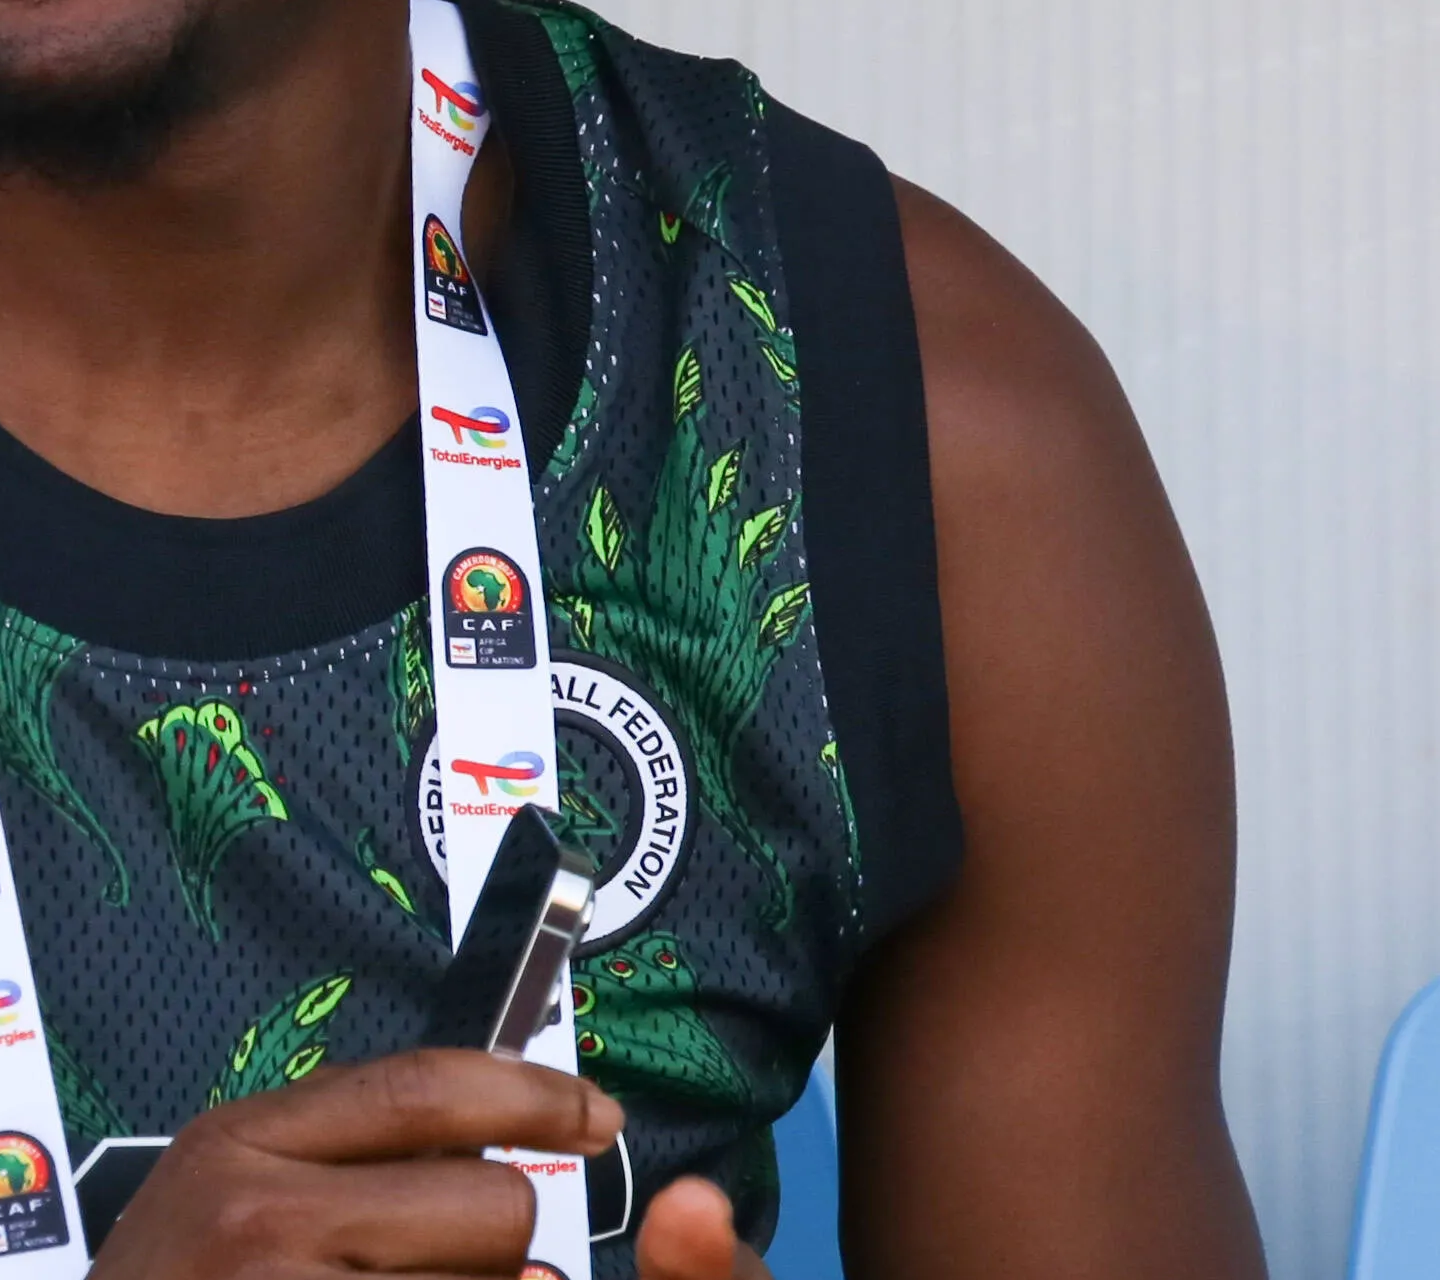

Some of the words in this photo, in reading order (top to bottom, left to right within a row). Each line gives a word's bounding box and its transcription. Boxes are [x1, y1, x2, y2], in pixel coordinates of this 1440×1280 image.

[435, 276, 468, 296] CAF
[429, 446, 521, 470] TotalEnergies
[452, 555, 497, 581] CAMEROON
[462, 619, 514, 631] CAF
[608, 696, 679, 900] FEDERATION
